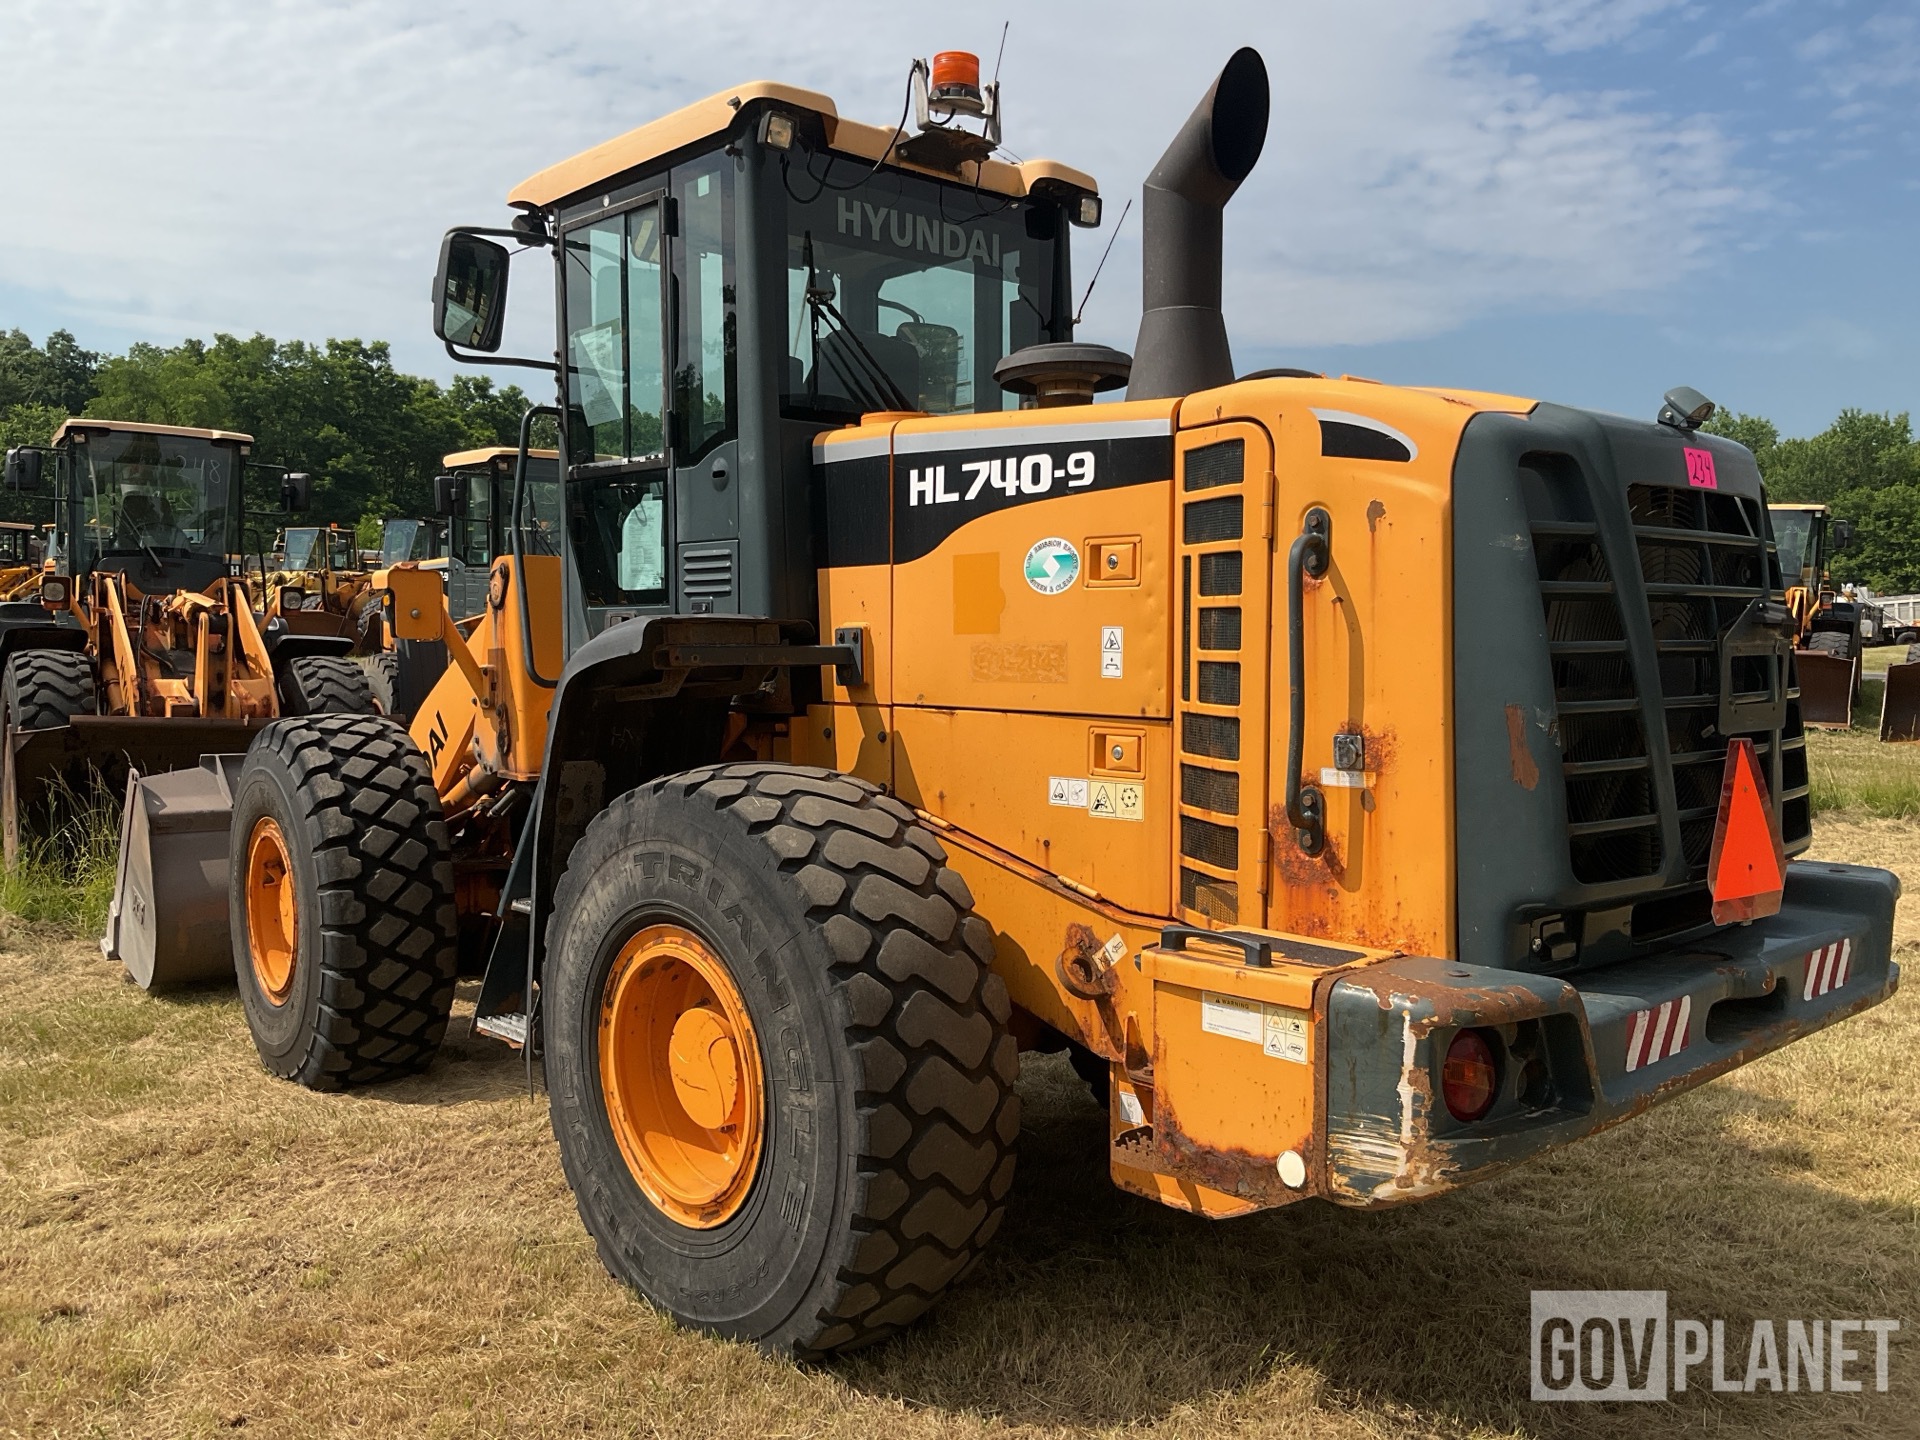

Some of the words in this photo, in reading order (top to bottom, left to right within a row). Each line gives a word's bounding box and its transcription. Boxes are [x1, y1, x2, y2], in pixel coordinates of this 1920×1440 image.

[837, 196, 1000, 268] HYUNDAI
[176, 454, 221, 484] 248
[1688, 452, 1713, 486] 234
[1222, 998, 1250, 1010] WARNING
[633, 851, 811, 1232] TRIANGLE
